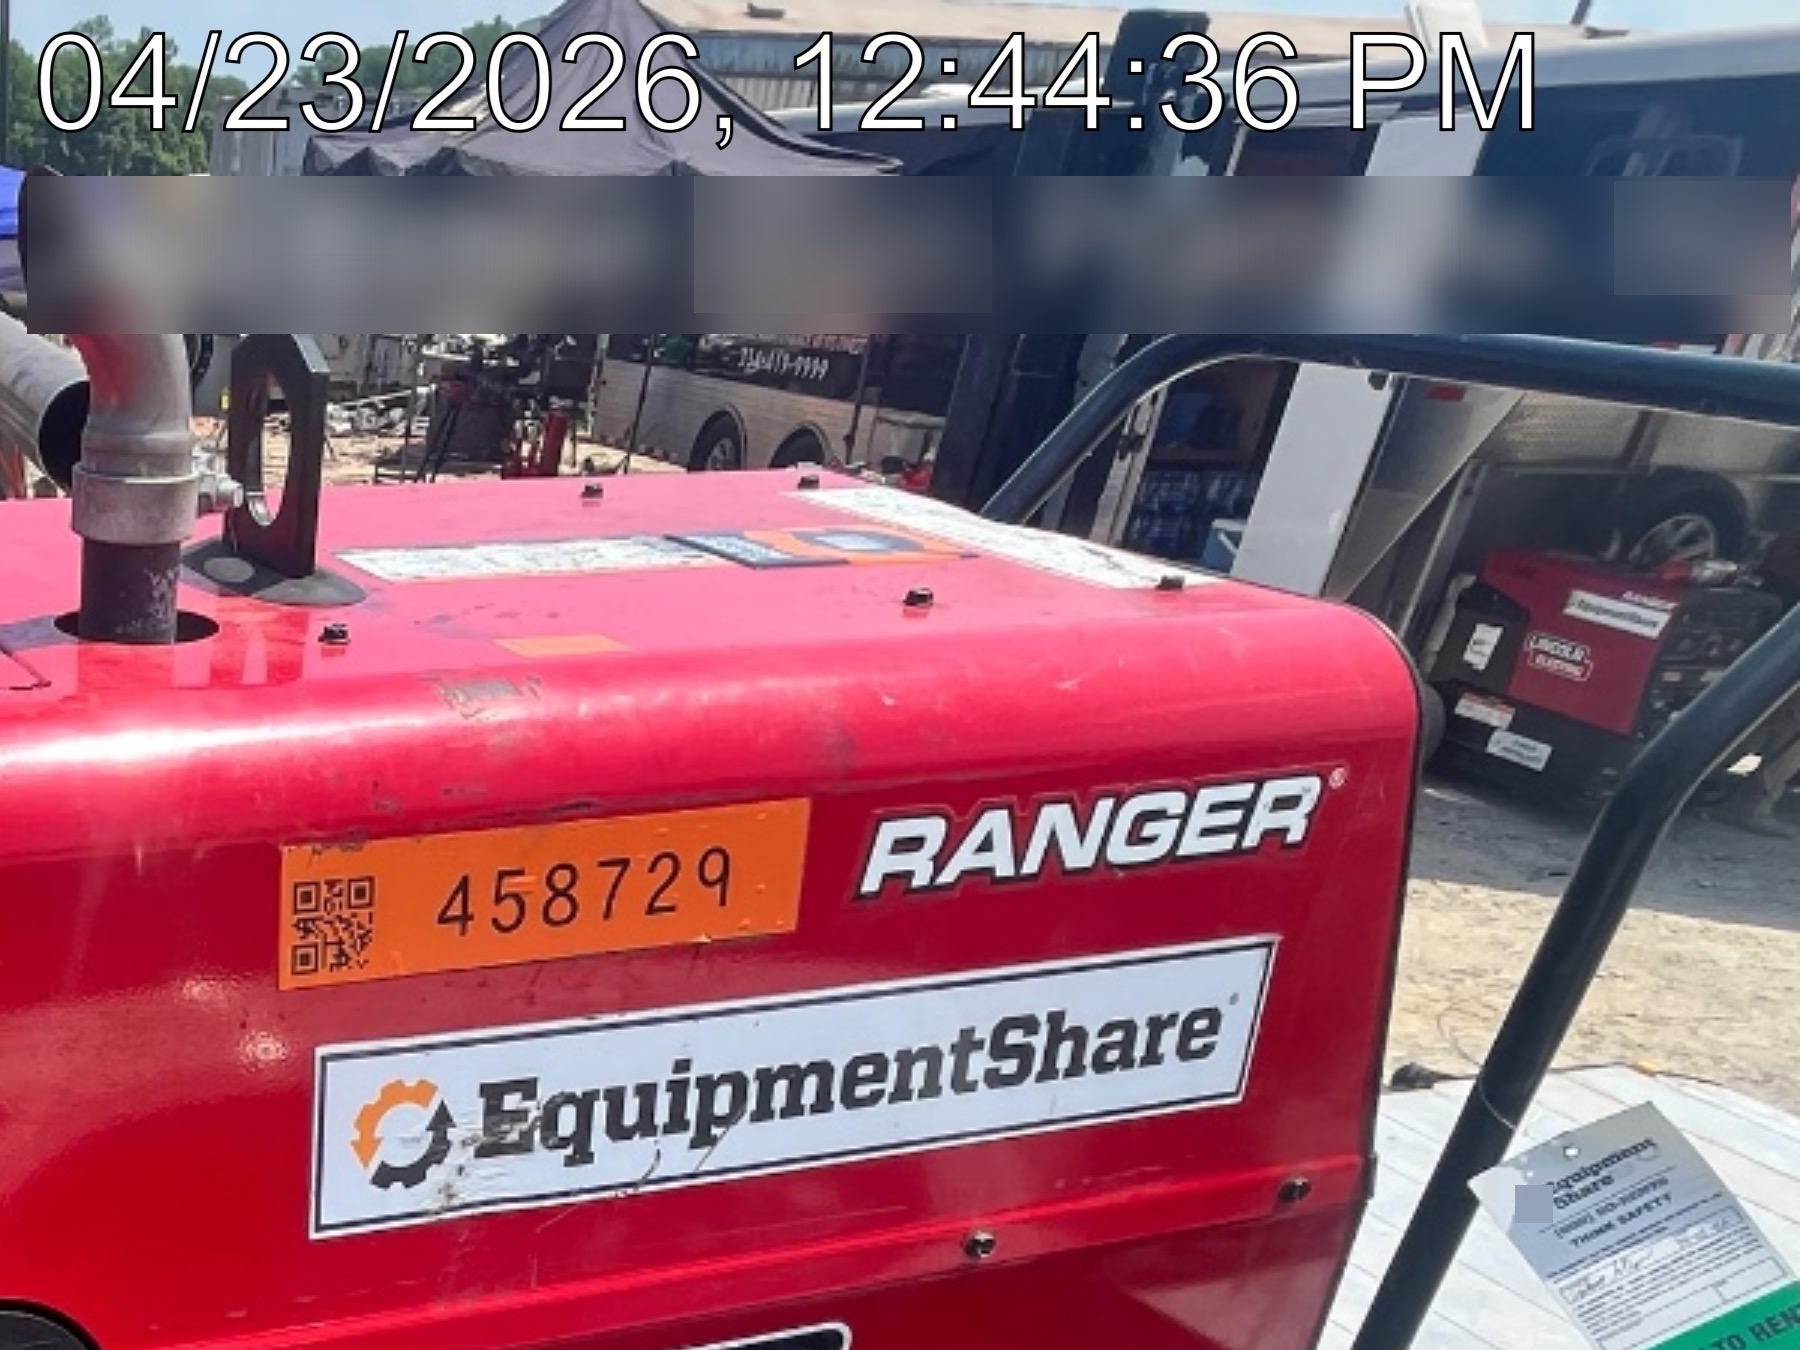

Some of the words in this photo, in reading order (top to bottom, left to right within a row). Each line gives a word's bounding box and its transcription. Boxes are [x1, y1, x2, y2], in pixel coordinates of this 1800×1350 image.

[859, 773, 1318, 895] RANGER
[436, 845, 734, 938] 458729
[473, 1002, 1225, 1167] EquipmentShare
[1552, 1174, 1616, 1210] Share
